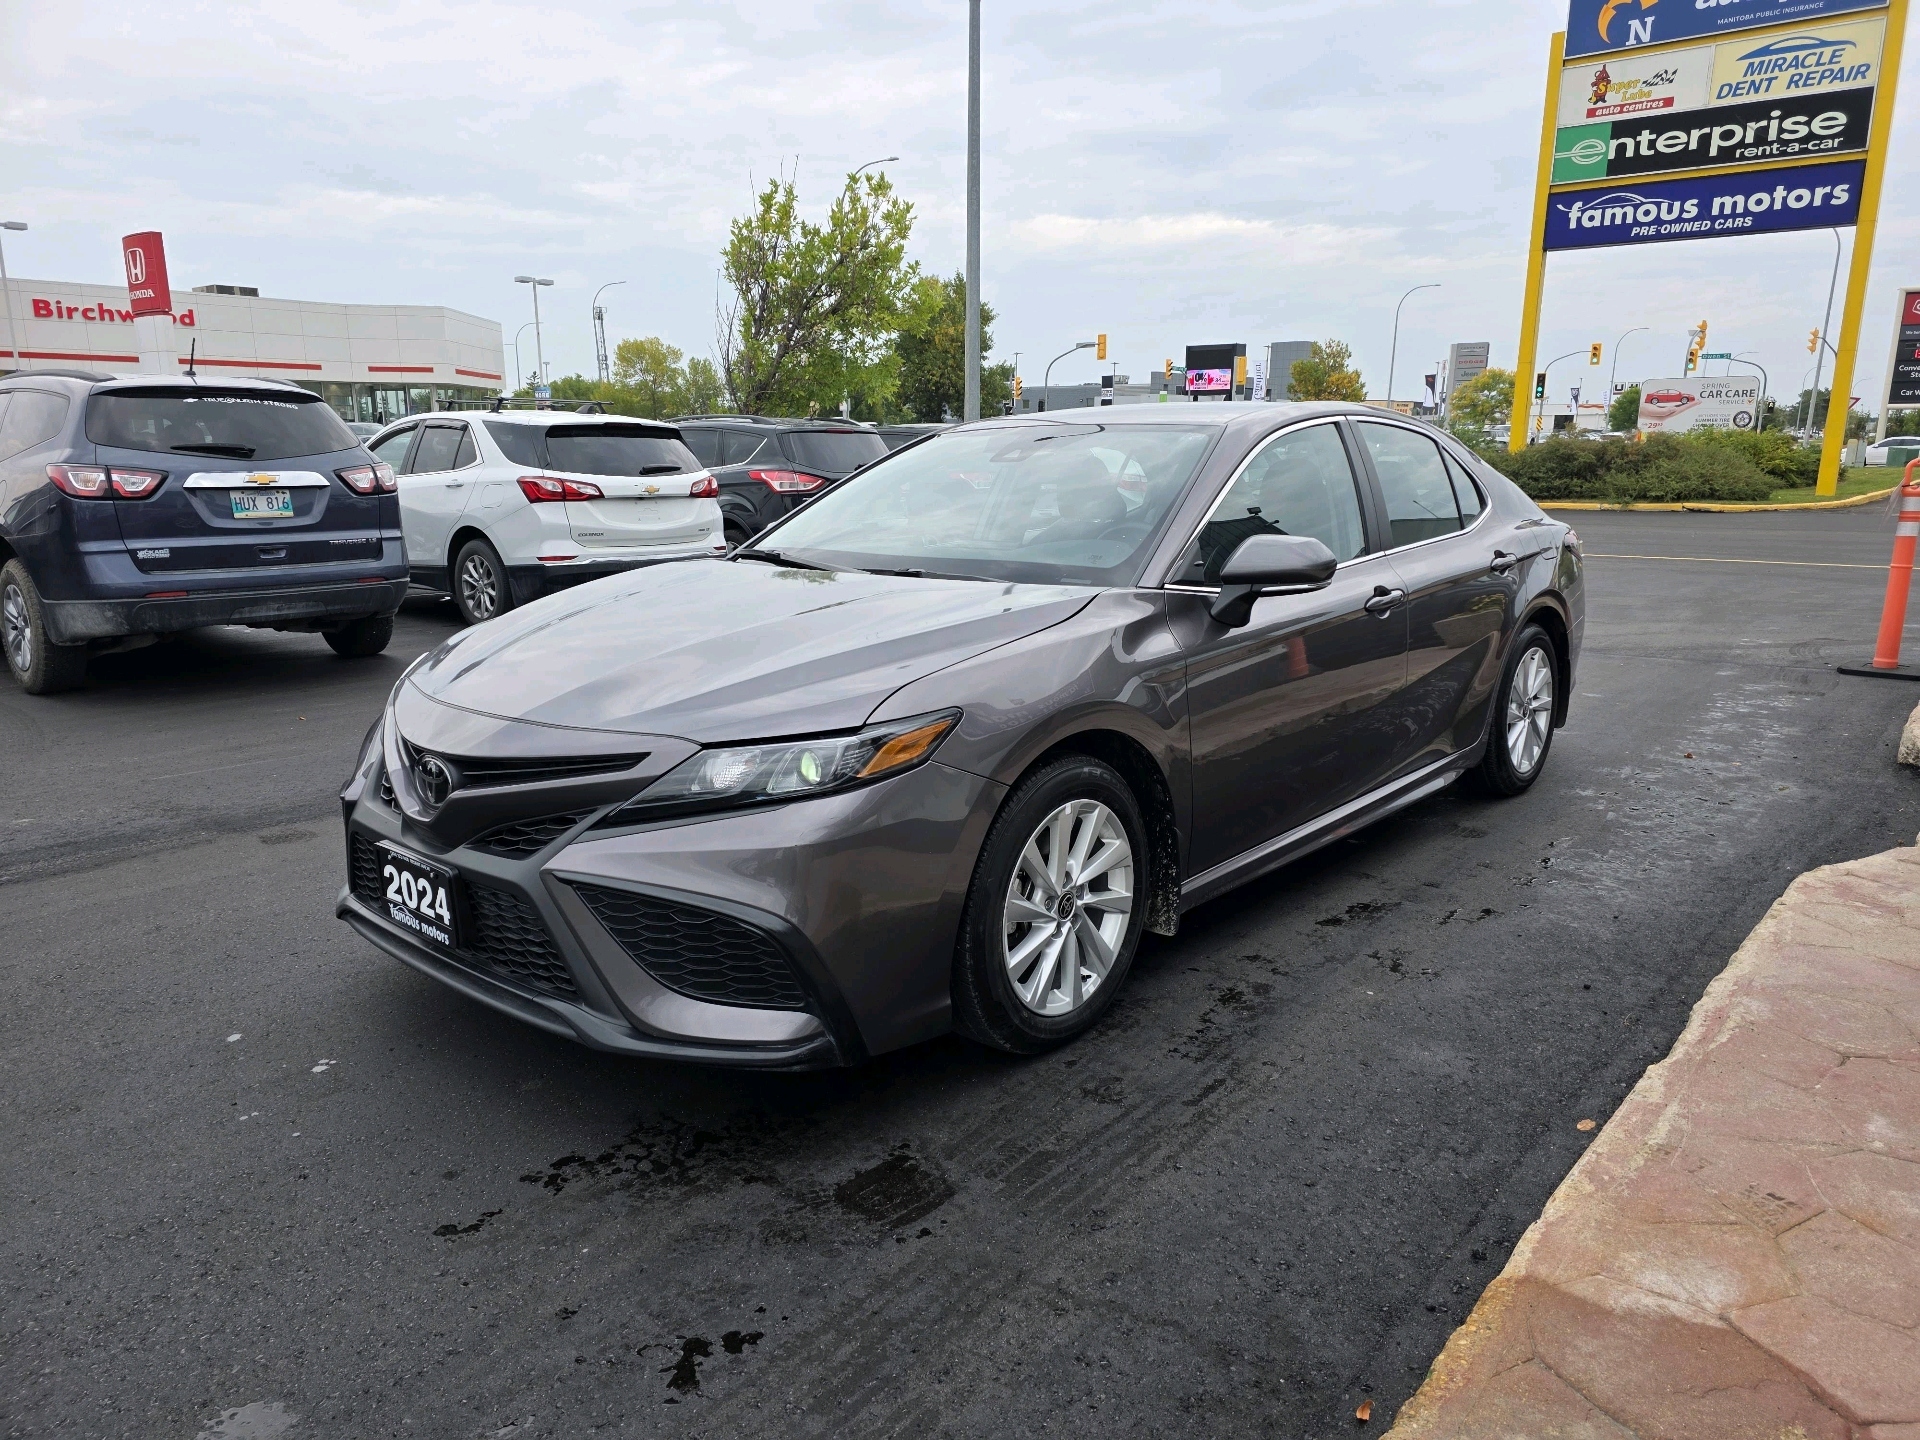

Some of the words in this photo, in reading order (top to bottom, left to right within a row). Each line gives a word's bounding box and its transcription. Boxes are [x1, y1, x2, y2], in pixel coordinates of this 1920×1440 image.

[1717, 13, 1755, 25] MANITOBA
[1755, 8, 1781, 18] PUBLIC
[1782, 1, 1824, 14] INSURANCE
[1742, 47, 1846, 78] MIRACLE
[1597, 79, 1641, 94] Super
[1716, 76, 1779, 100] DENT
[1785, 63, 1871, 90] REPAIR
[1621, 89, 1652, 102] Lube
[1595, 106, 1620, 116] auto
[1622, 100, 1664, 112] centres
[1568, 110, 1848, 164] enterprise
[1735, 136, 1844, 159] rent-a-car
[1567, 198, 1699, 229] famous
[1711, 184, 1850, 216] motors
[1630, 220, 1711, 238] PRE-OWNED
[1713, 216, 1753, 230] CARS
[32, 297, 196, 327] Birchwd
[1699, 390, 1723, 399] CAR
[1725, 388, 1756, 398] CARE
[1701, 382, 1731, 390] SPRING
[234, 496, 259, 511] HUX
[266, 496, 290, 510] 816
[383, 864, 450, 926] 2024
[388, 903, 420, 930] famous
[420, 922, 449, 946] motors
